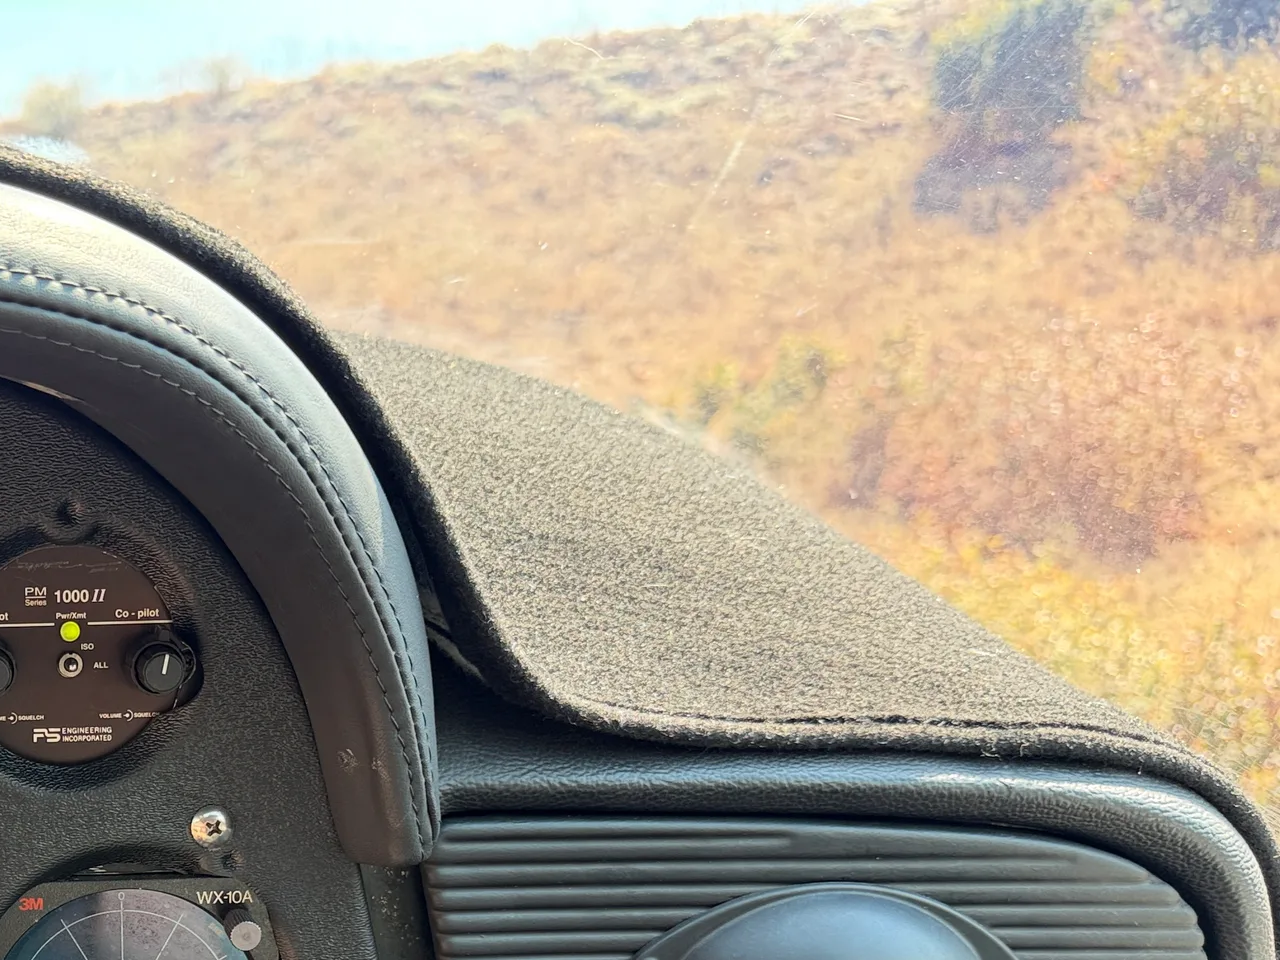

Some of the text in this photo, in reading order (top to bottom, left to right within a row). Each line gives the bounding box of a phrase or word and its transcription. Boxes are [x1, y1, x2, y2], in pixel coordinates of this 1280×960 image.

[25, 587, 47, 596] PM
[56, 612, 86, 620] Pwr/Xmt
[197, 890, 252, 904] WX-10A
[19, 898, 43, 910] 3M
